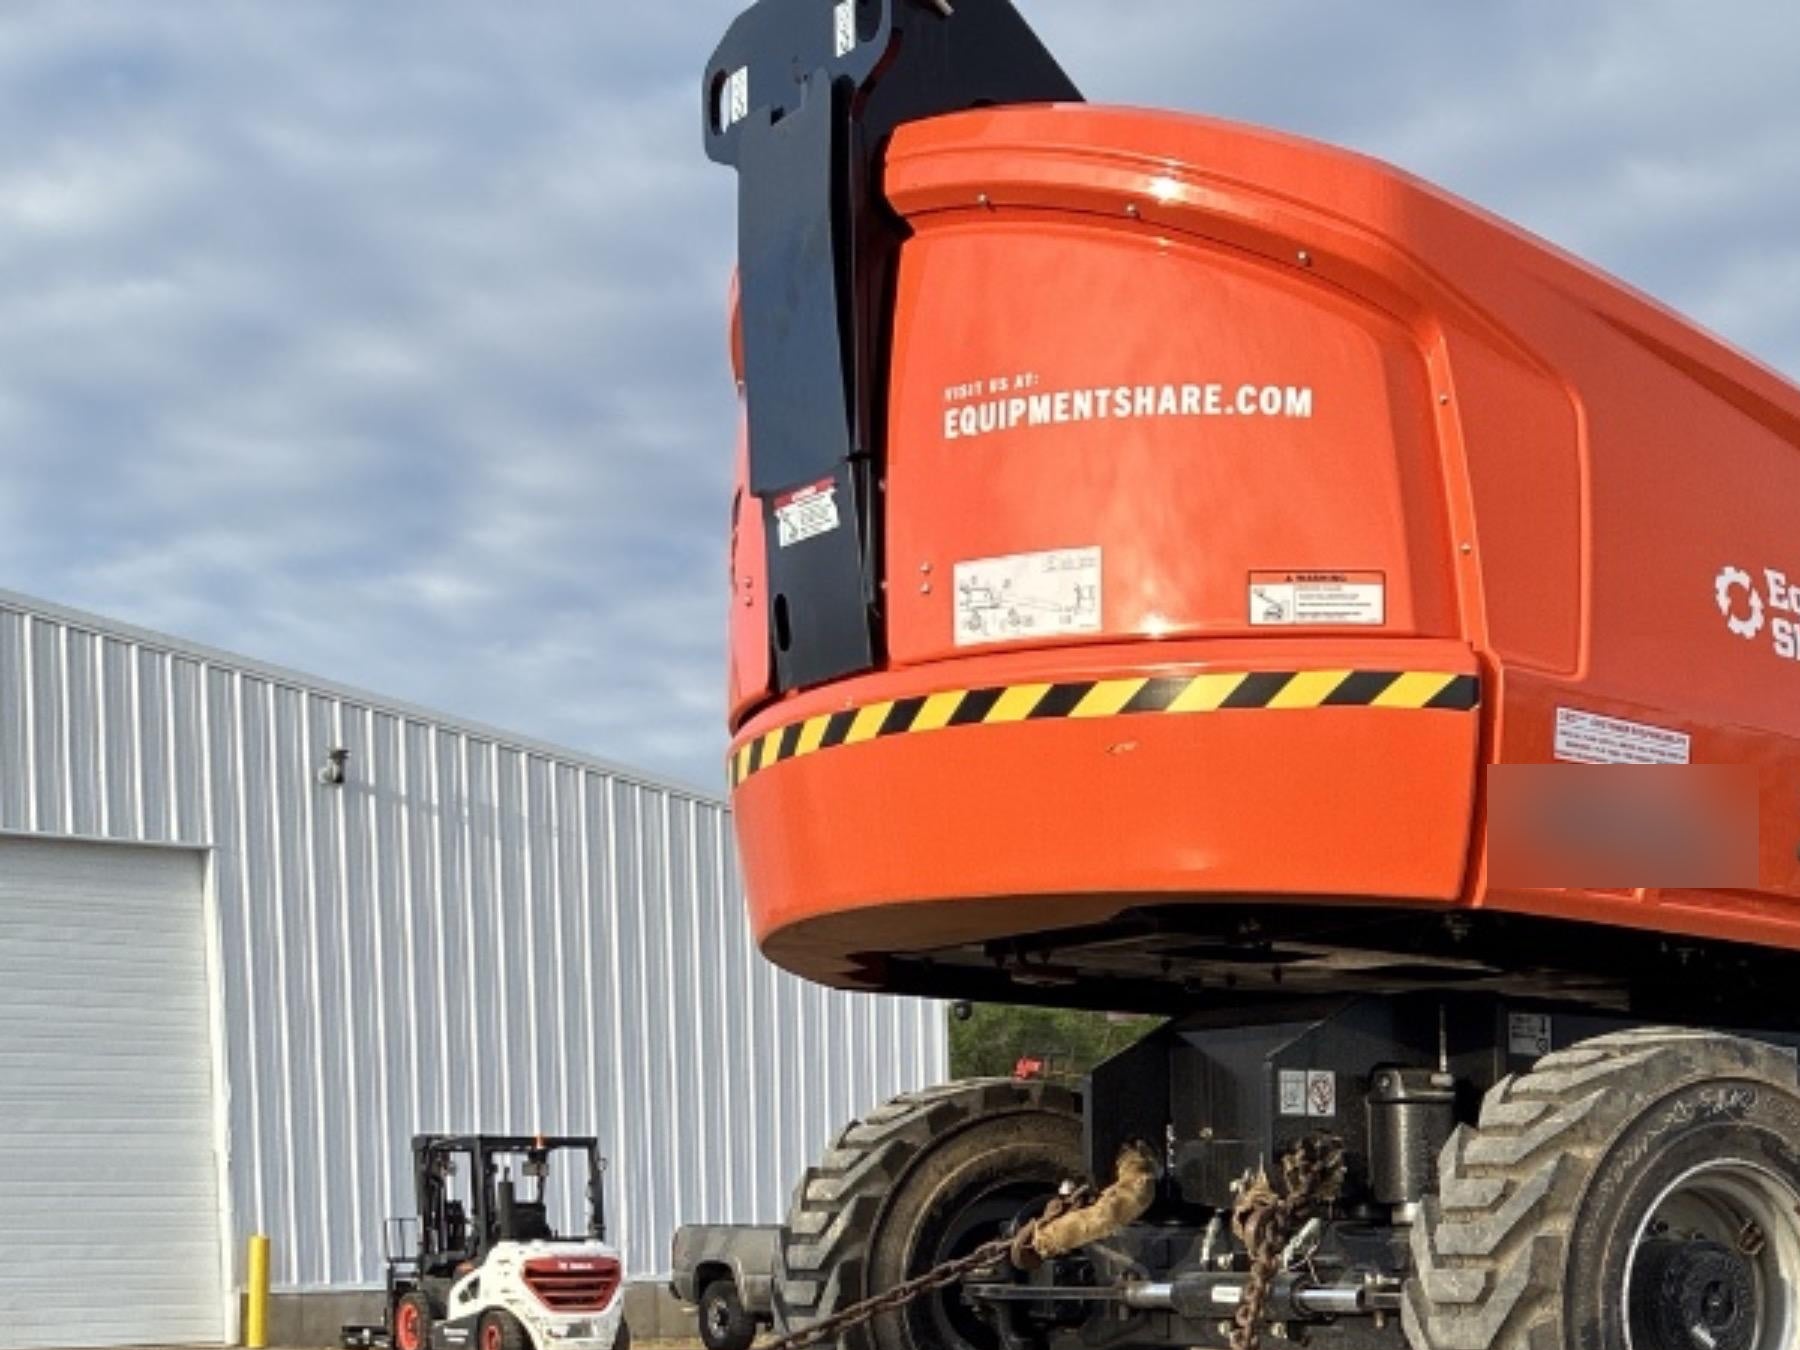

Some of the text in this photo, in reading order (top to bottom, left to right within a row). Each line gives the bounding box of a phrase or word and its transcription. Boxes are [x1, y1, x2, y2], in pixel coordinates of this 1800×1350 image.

[944, 372, 1039, 401] VISIT US AT:
[944, 384, 1312, 439] EQUIPMENTSHARE.COM
